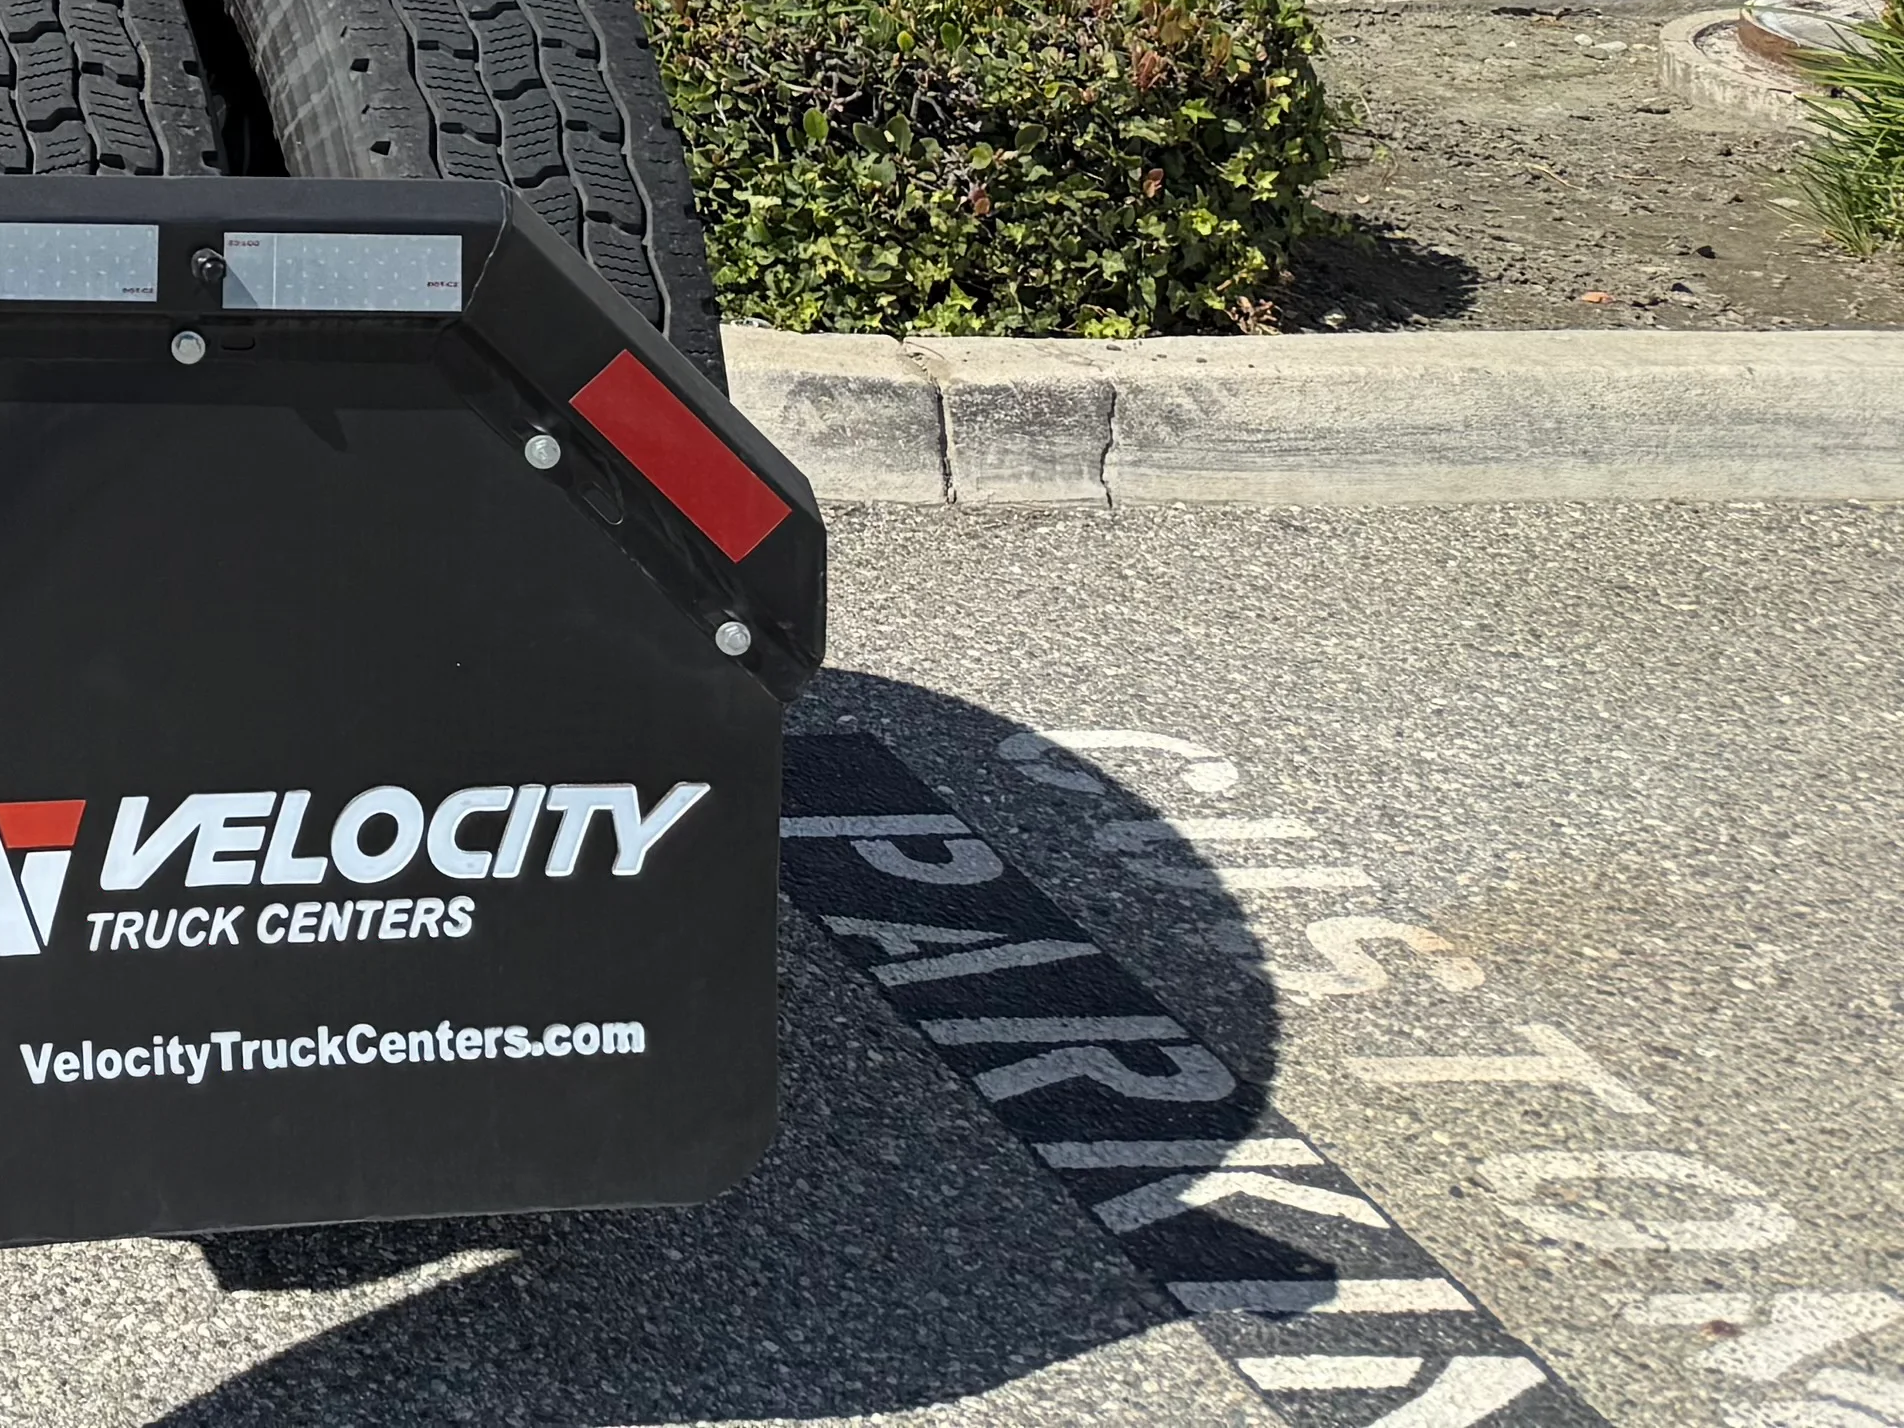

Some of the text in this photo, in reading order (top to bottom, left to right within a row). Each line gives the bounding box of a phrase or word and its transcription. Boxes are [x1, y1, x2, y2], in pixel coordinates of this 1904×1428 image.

[100, 782, 712, 890] VELOCITY
[85, 895, 475, 952] TRUCK CENTERS
[18, 1018, 646, 1084] VelocityTruckCenters.com
